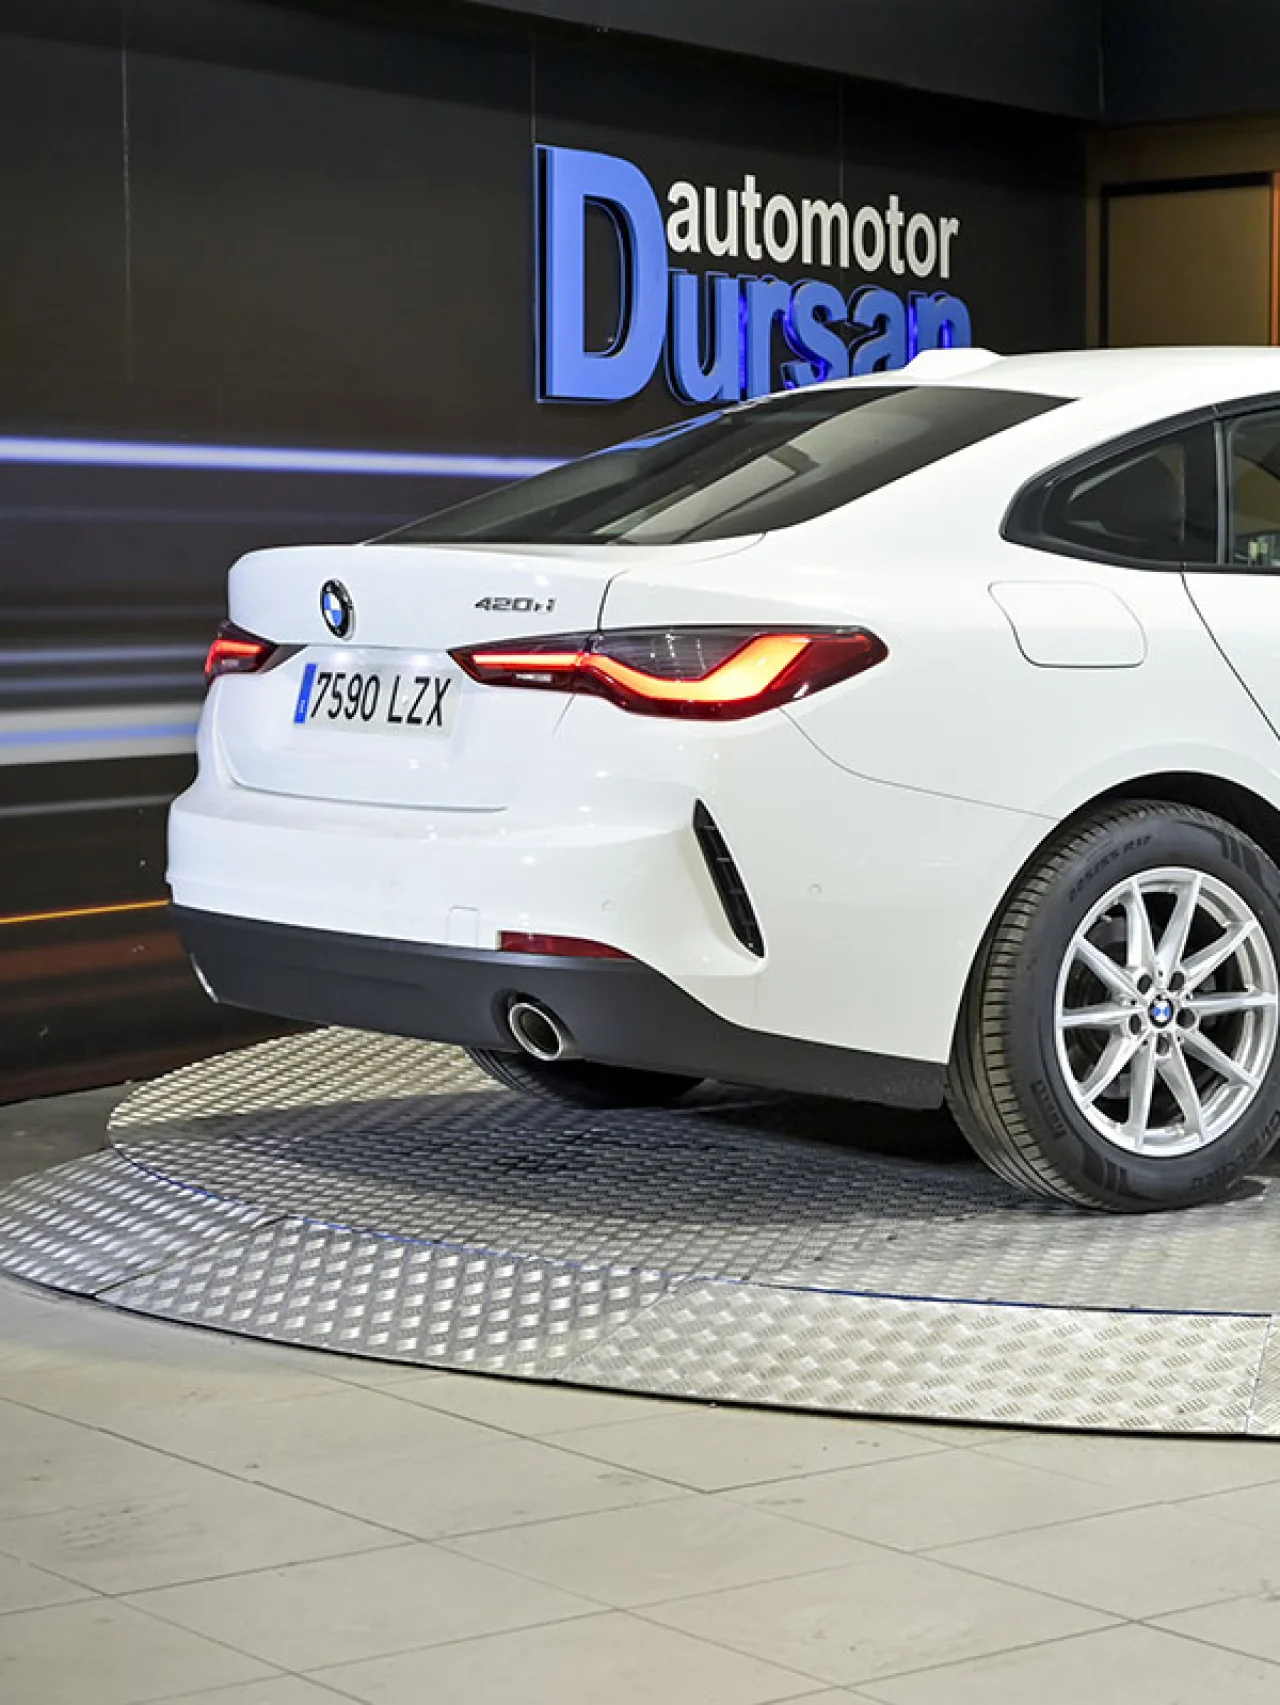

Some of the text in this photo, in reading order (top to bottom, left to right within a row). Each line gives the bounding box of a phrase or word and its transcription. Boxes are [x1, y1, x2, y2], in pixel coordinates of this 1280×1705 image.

[535, 145, 972, 405] Dursan
[667, 174, 960, 279] automotor
[311, 672, 452, 727] 7590 LZX
